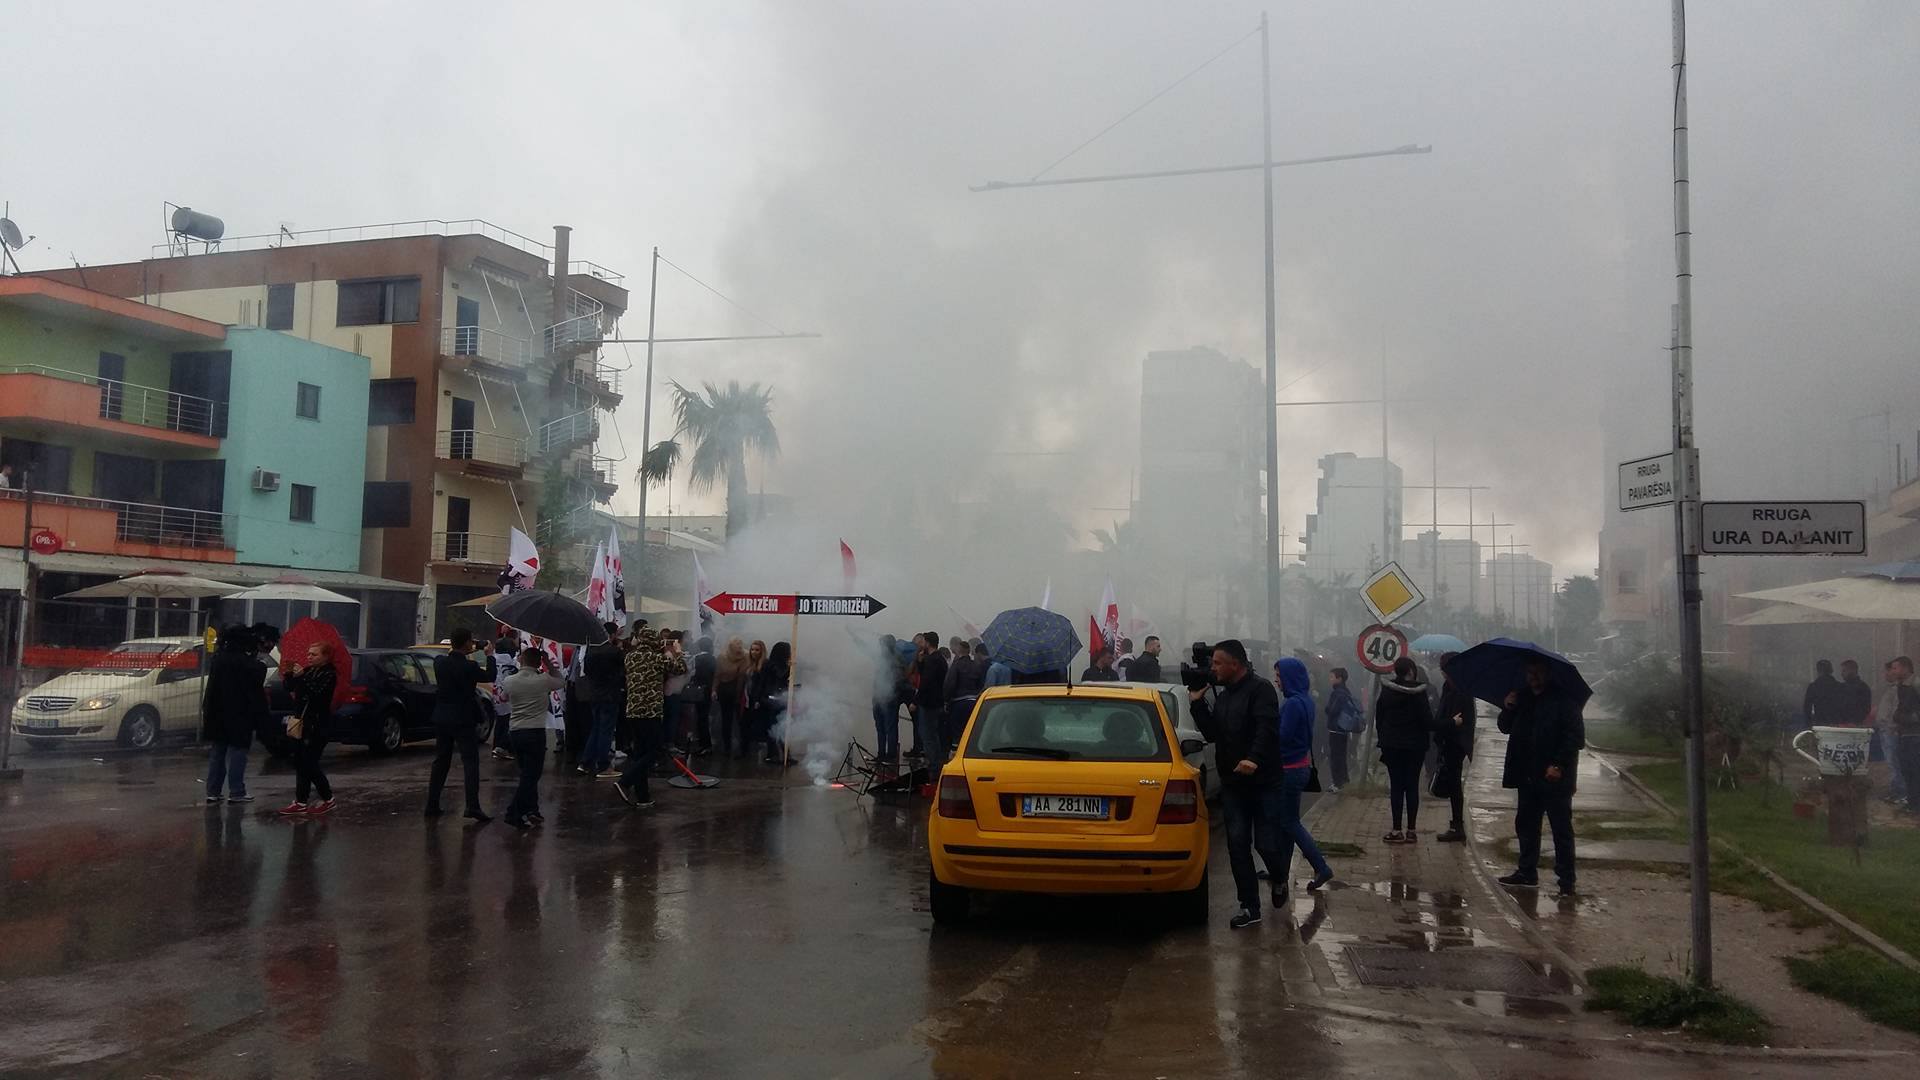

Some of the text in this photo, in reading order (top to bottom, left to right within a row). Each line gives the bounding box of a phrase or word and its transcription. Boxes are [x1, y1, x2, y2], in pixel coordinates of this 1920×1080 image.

[1637, 463, 1661, 477] RRUGA
[1628, 482, 1672, 501] PAVARËSIA
[1752, 509, 1811, 521] RRUGA
[1713, 531, 1853, 544] URA DAJLANIT
[732, 596, 778, 611] TURIZËM
[799, 597, 870, 614] JO TERRORIZËM
[1366, 637, 1397, 661] 40
[1035, 797, 1050, 811] AA
